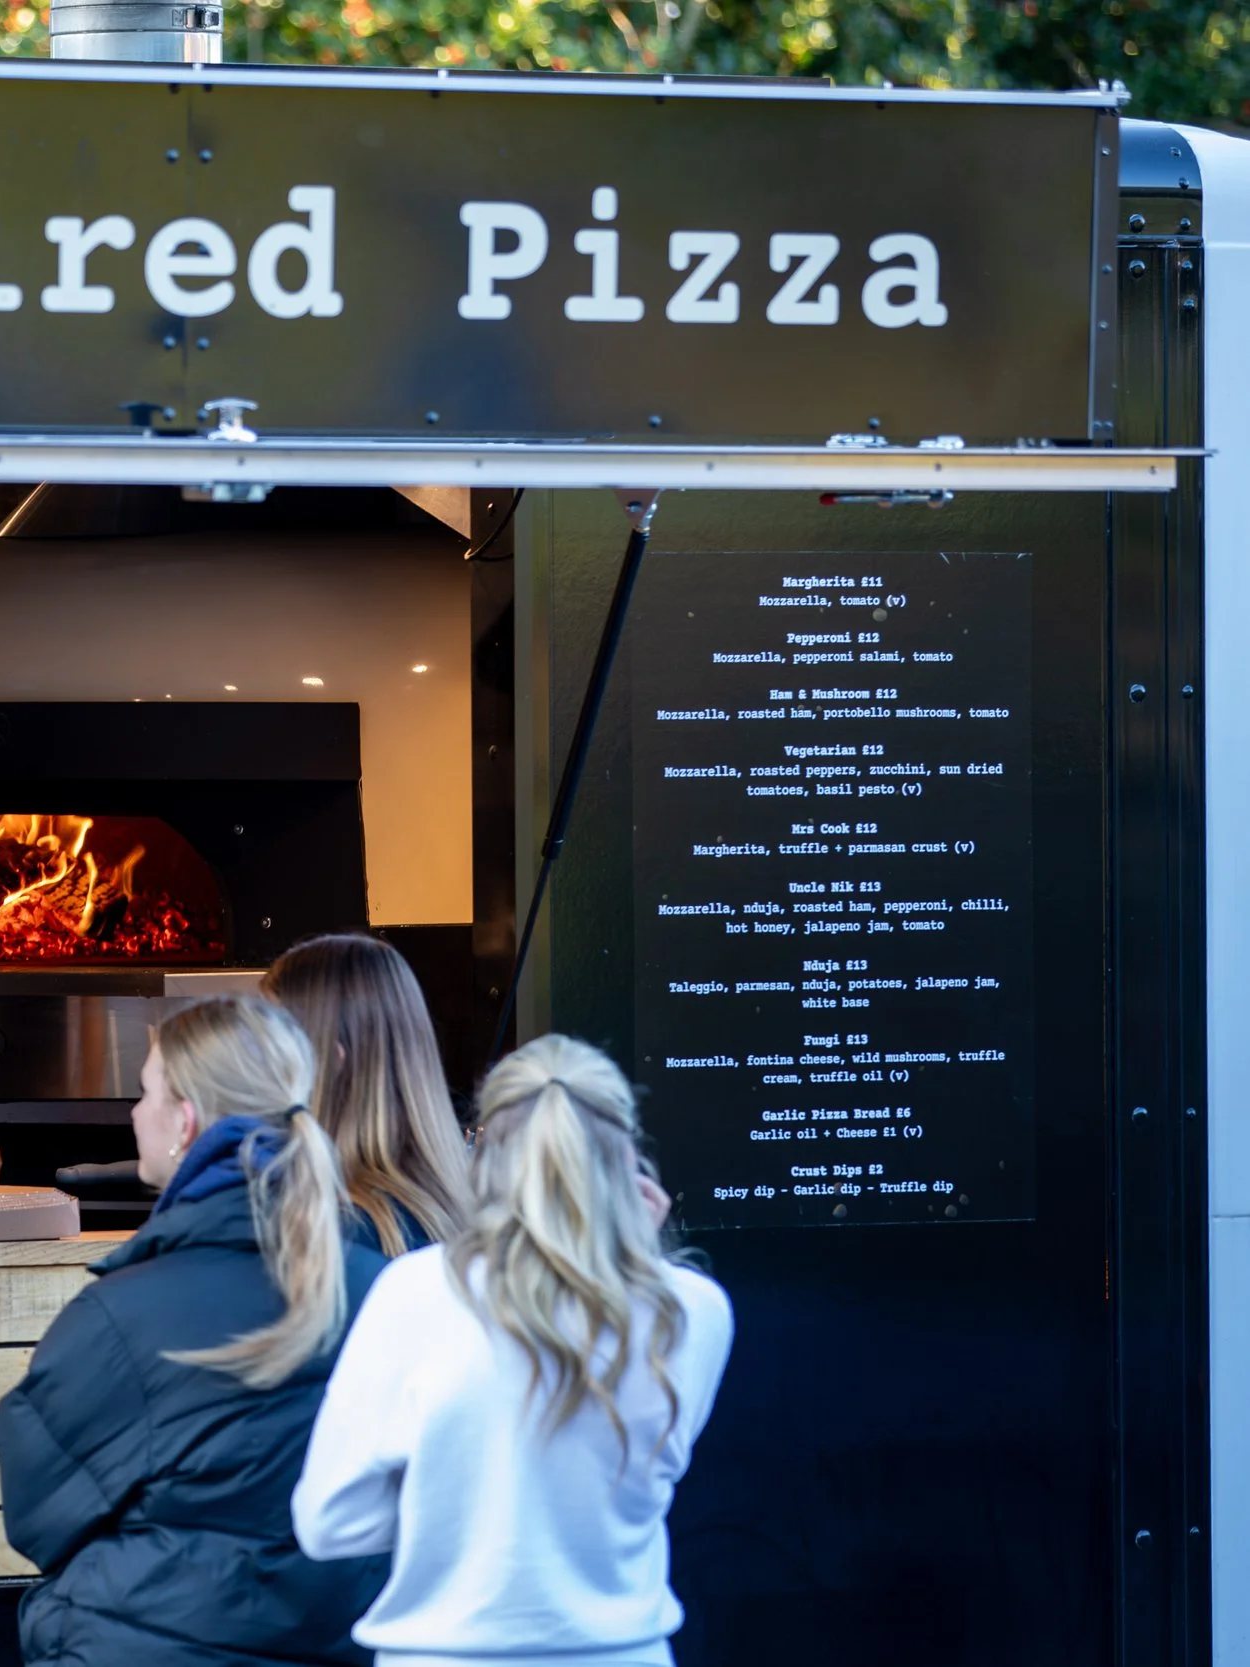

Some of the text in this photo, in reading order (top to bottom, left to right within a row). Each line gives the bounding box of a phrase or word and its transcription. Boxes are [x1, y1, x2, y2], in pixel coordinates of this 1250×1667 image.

[457, 186, 950, 330] Pizza
[781, 575, 884, 591] Margherita £11
[758, 594, 907, 608] Mozzarella, tomato (v)
[786, 631, 881, 647] Pepperoni £12
[712, 650, 954, 665] Mozzarella, pepperoni salami, tomato
[769, 687, 899, 701] Ham & Mushroom £12
[656, 706, 1010, 722] Mozzarella, roasted ham, portobello mushrooms, tomato
[783, 743, 885, 759] Vegetarian £12
[663, 762, 1004, 779] Mozzarella, roasted peppers, zucchini, sun dried
[745, 782, 923, 798] tomatoes, basil pesto (v)
[790, 822, 879, 835] Mrs Cook £12
[692, 840, 976, 859] Margherita, truffle + parmasan crust (v)
[788, 880, 882, 894] Uncle Nik £13
[657, 898, 1010, 916] Mozzarella, nduja, roasted ham, pepperoni, chilli,
[725, 919, 946, 936] hot honey, jalapeno jam, tomato
[802, 959, 869, 974] Nduja £13
[668, 975, 1001, 996] Taleggio, parmesan, nduja, potatoes, jalapeno jam,
[801, 996, 871, 1009] white base
[802, 1033, 869, 1049] Fungi £13
[665, 1049, 1006, 1069] Mozzarella, fontina cheese, wild mushrooms, truffle
[762, 1069, 910, 1085] cream, truffle oil (v)
[761, 1106, 912, 1122] Garlic Pizza Bread £6
[749, 1124, 924, 1141] Garlic oil + Cheese £1 (v)
[790, 1163, 885, 1179] Crust Dips £2
[713, 1185, 750, 1201] Spicy
[753, 1184, 776, 1200] dip
[792, 1183, 834, 1196] Garlic
[839, 1182, 862, 1196] dip
[879, 1180, 928, 1194] Truffle
[931, 1179, 955, 1195] dip
